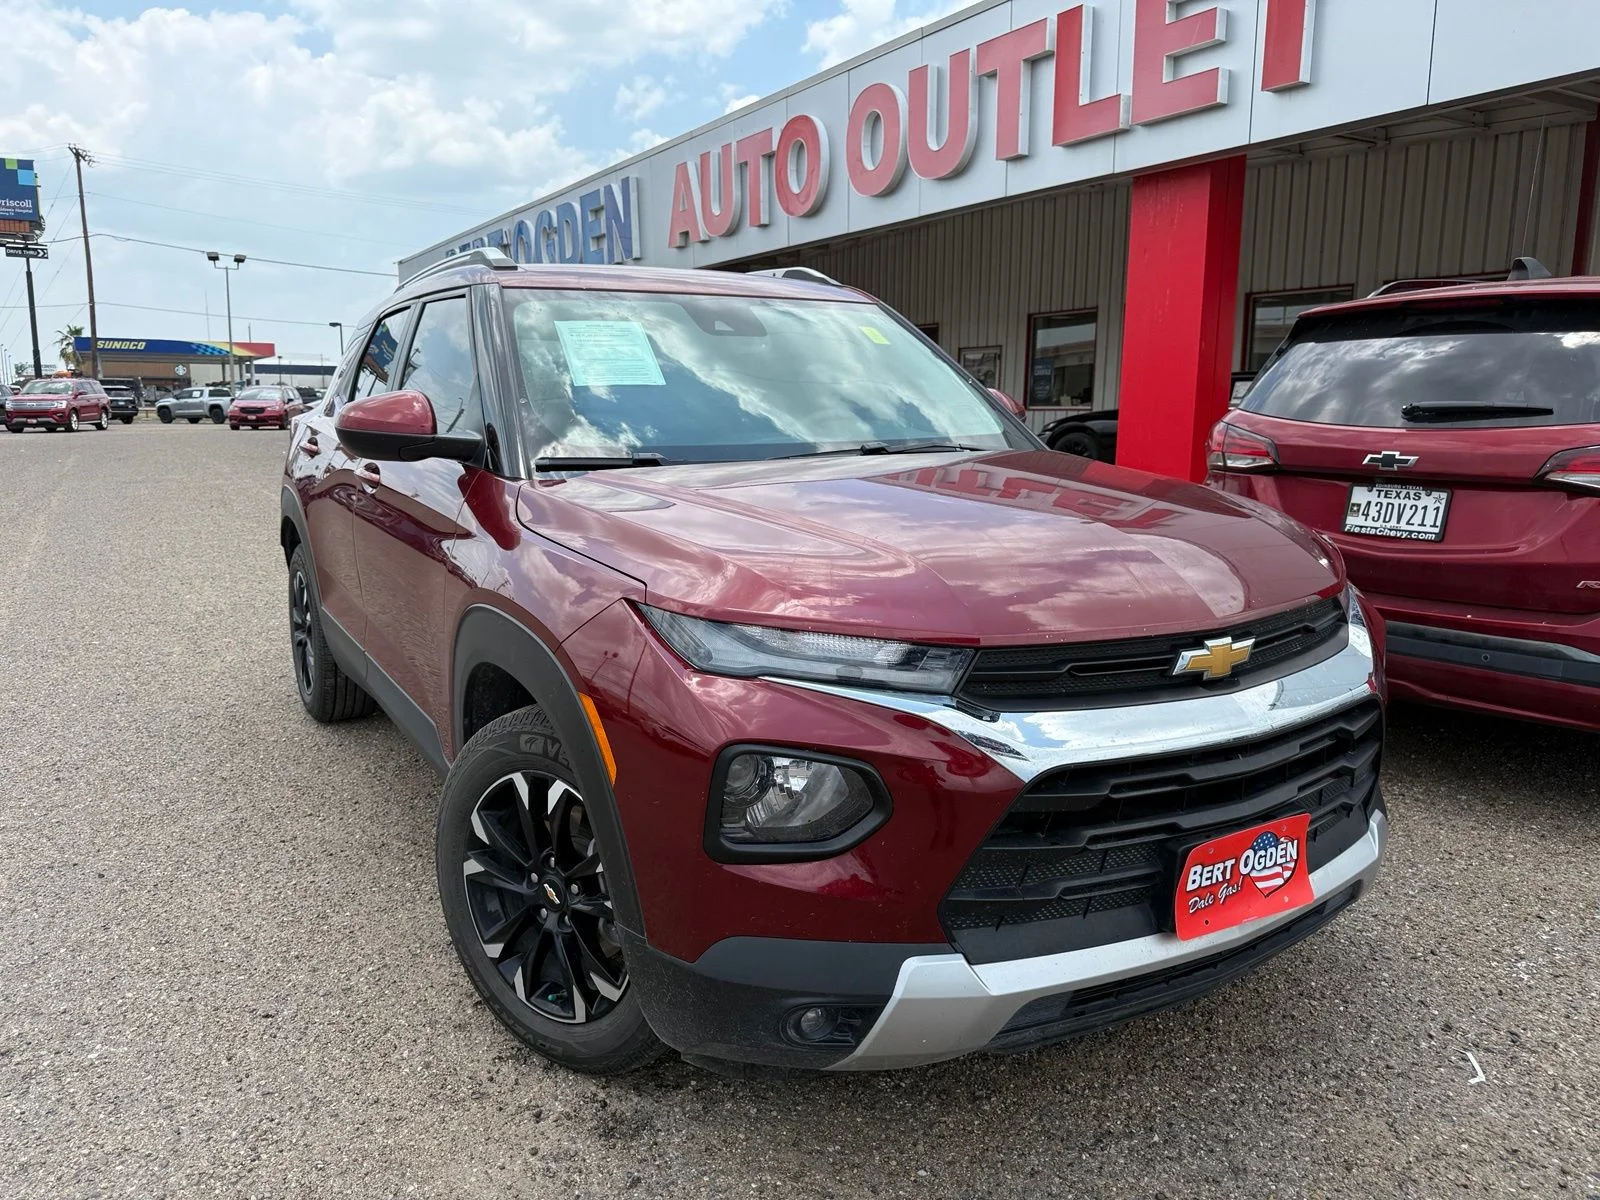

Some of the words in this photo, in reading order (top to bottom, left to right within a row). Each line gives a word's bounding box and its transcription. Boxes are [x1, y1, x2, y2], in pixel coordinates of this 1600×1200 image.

[513, 176, 643, 264] OGDEN
[668, 113, 830, 248] AUTO
[0, 198, 33, 208] riscoll
[96, 340, 147, 350] SUNOCO
[1375, 489, 1422, 501] TEXAS
[1361, 500, 1440, 528] 43DV211
[1344, 524, 1436, 540] FiestaChevy.com
[1186, 858, 1236, 892] BERT
[1239, 840, 1298, 875] OGDEN
[1188, 892, 1214, 913] Dale
[1217, 876, 1243, 904] Gas!
